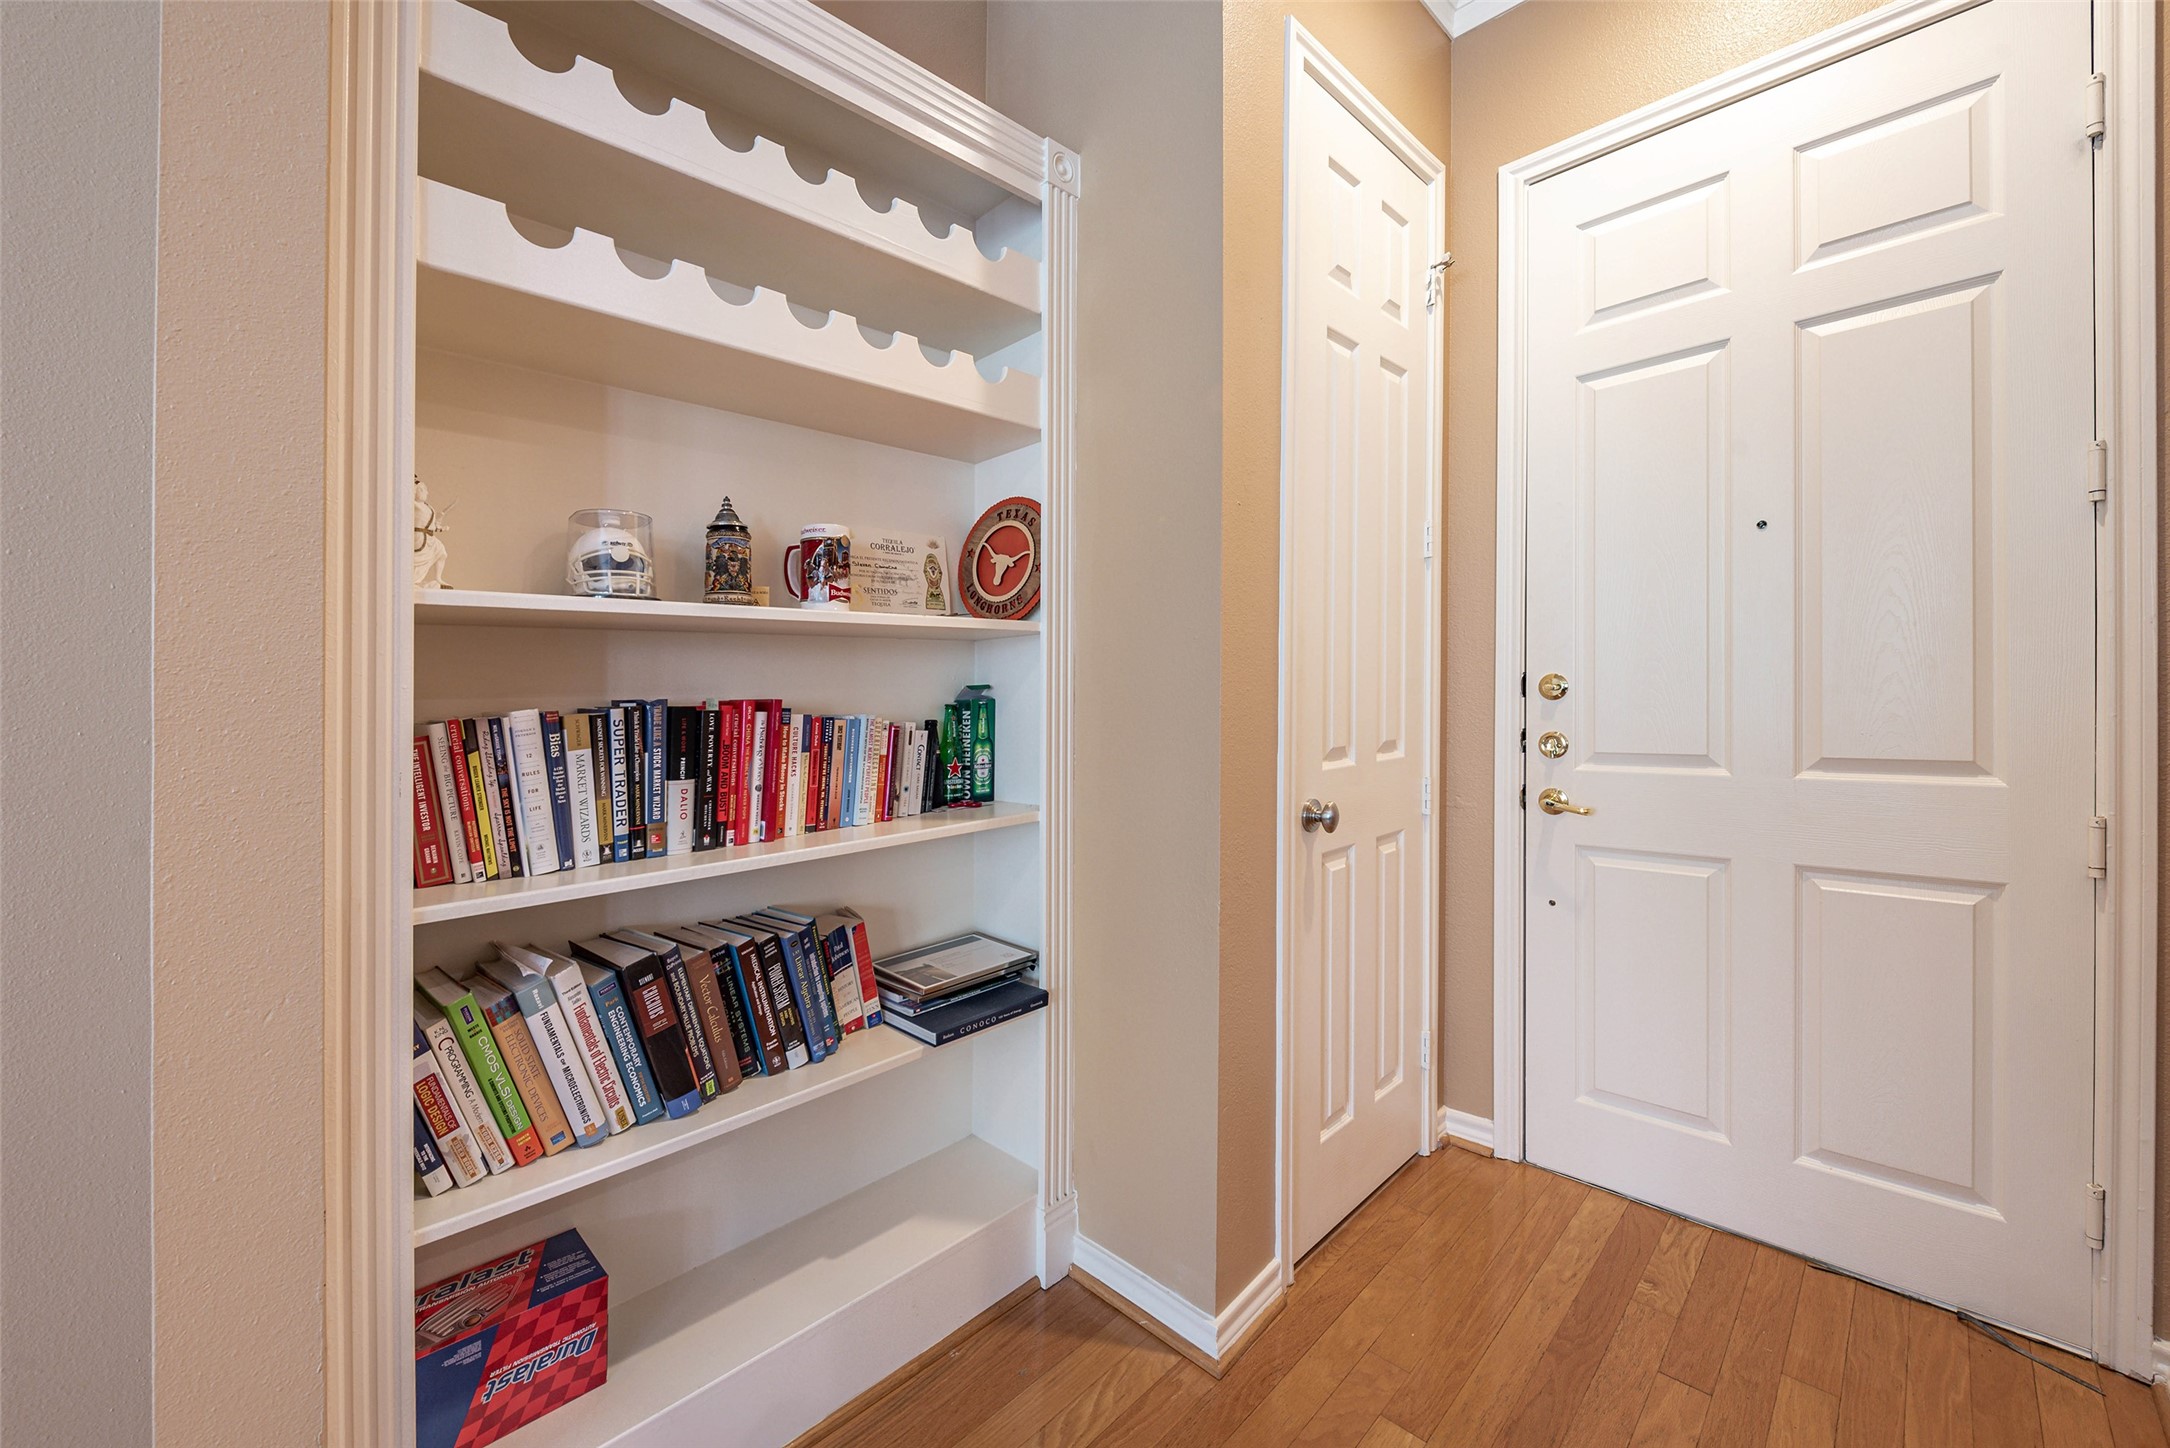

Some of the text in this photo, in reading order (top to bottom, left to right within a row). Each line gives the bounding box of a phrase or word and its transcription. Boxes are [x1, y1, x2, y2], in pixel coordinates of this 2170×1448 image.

[997, 508, 1037, 526] TEXAS
[870, 542, 915, 554] CORRALEJO
[864, 587, 898, 596] SENTIDOS
[967, 583, 1023, 614] LONGHORNS
[596, 718, 604, 740] MINDSET
[653, 705, 662, 725] TRADE
[732, 713, 740, 738] crucial
[449, 724, 463, 753] crucial
[547, 732, 562, 758] Bias
[653, 726, 662, 740] LIKE
[744, 723, 752, 745] CHINA
[791, 726, 799, 755] CULTURE
[653, 748, 662, 768] STOCK
[730, 739, 739, 786] conversations
[869, 720, 882, 792] SUPERFORECASTING
[963, 710, 971, 799] OWN HEINEKEN
[436, 736, 458, 821] SEEING BIG PICTURE
[454, 755, 472, 811] conversations
[599, 769, 607, 797] WINNING
[612, 719, 627, 827] SUPER TRADER
[652, 769, 662, 794] MARKET
[719, 744, 731, 814] BOOM AND BUST
[778, 763, 786, 785] Money
[414, 760, 431, 832] INTELLIGENT INVESTOR
[501, 787, 509, 798] THE
[502, 798, 510, 809] SKY
[575, 753, 591, 843] MARKET WIZARDS
[678, 788, 689, 820] DALIO
[505, 815, 513, 827] NOT
[651, 796, 661, 820] WIZARD
[508, 838, 517, 852] LIMIT
[748, 953, 763, 981] MEDICAL
[768, 962, 785, 989] POWER
[793, 956, 807, 980] Linear
[531, 988, 545, 1010] Razavi
[640, 986, 665, 1020] CALCULUS
[695, 974, 717, 1006] Vector
[772, 983, 791, 1010] SYSTEM
[798, 980, 815, 1009] Algebra
[669, 972, 701, 1058] and BOUNDARY VALUE PROBLEMS
[674, 967, 693, 1002] ELEMENTARY
[685, 1001, 704, 1039] DIFFERENTIAL
[696, 1037, 714, 1070] EQUATIONS
[725, 975, 741, 1009] LINEAR
[733, 1010, 752, 1053] SYSTEMS
[755, 980, 778, 1037] INSTRUMENTATION
[614, 1005, 642, 1068] CONTEMPORARY
[703, 1005, 728, 1044] Calculus
[959, 1015, 998, 1035] CONOCO
[435, 1035, 455, 1052] C
[512, 1027, 542, 1080] SOLID STATE
[572, 1002, 622, 1110] Fundamentals of Electric Circuits
[607, 1009, 647, 1108] ENGINEERING ECONOMICS
[443, 1045, 475, 1099] PROGRAMMING
[476, 1035, 525, 1130] CMOS VLSI DESIGN
[503, 1033, 550, 1123] ELECTRONIC DEVICES
[539, 1011, 565, 1059] FUNDAMENTALS
[561, 1065, 592, 1125] MICROELECTRONICS
[415, 1081, 449, 1137] LOGIC DESIGN
[425, 1076, 457, 1131] FUNDAMENTALS OF
[415, 1248, 534, 1307] ralast
[482, 1327, 597, 1405] Duralast
[512, 1338, 561, 1367] TRANSMISSION
[489, 1362, 512, 1378] FILTER
